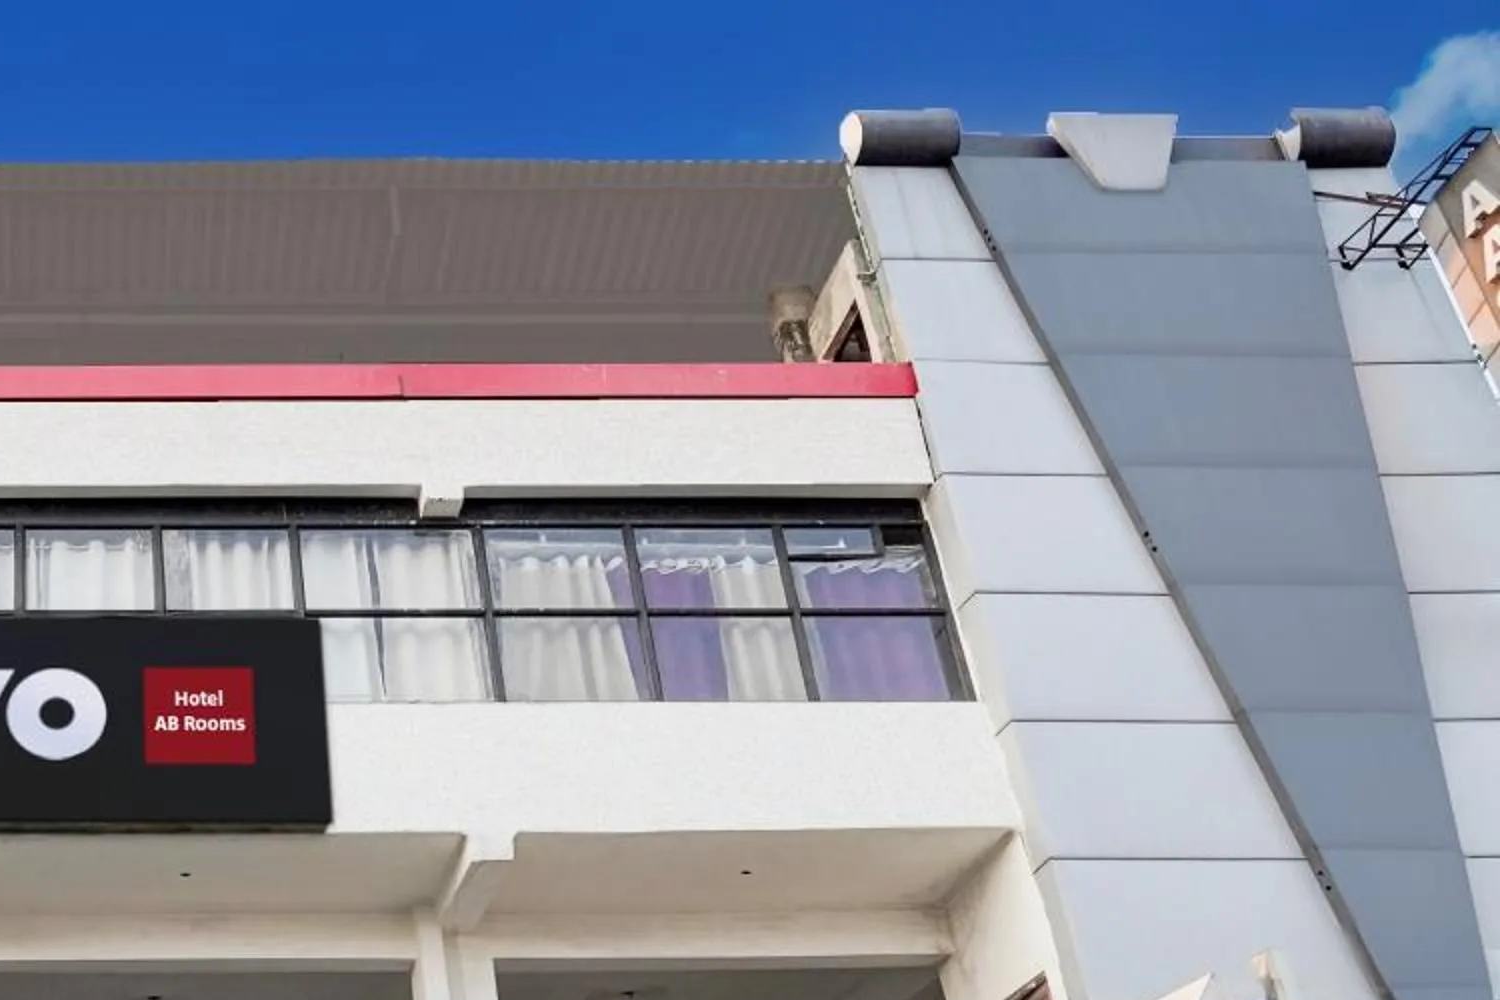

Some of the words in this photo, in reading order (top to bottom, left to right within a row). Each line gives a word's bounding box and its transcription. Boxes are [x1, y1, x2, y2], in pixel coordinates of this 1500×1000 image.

[173, 689, 225, 708] Hotel
[154, 715, 180, 732] AB
[183, 715, 246, 732] Rooms
